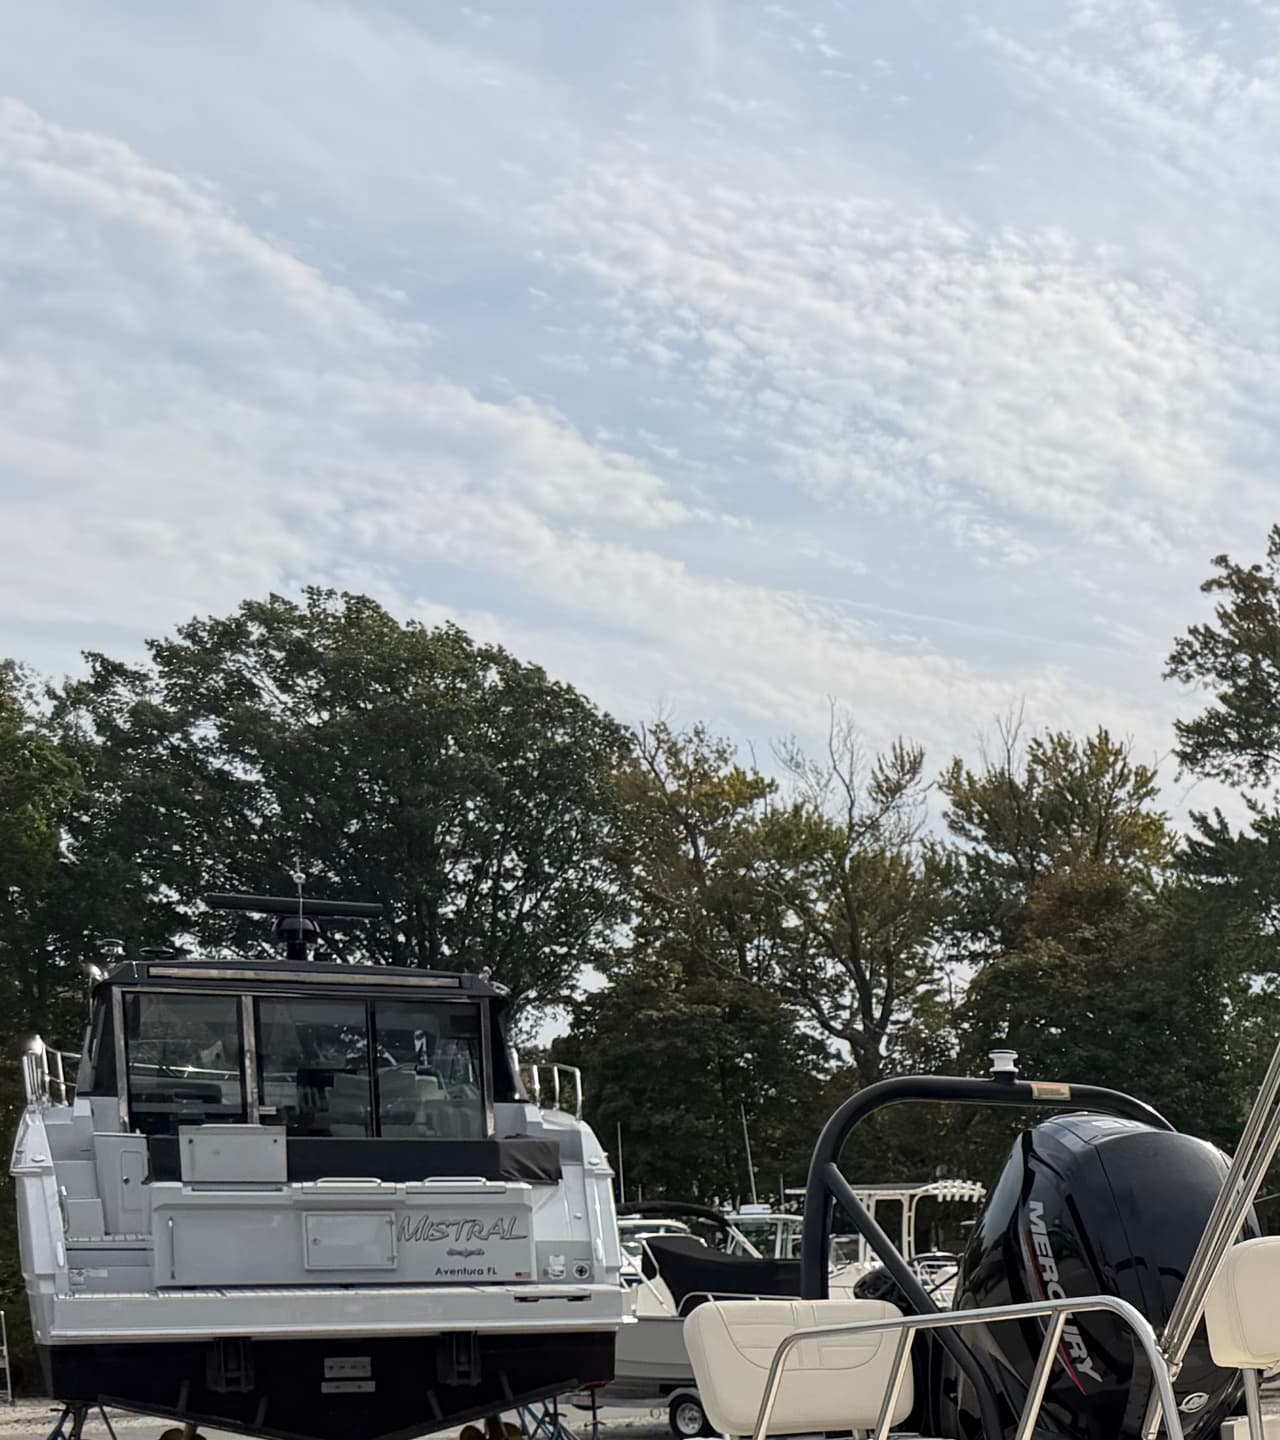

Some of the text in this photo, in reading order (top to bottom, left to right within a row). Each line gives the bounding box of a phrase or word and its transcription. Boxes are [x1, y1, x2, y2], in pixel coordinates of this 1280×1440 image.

[398, 1214, 529, 1242] MISTRAL
[435, 1266, 498, 1277] Aventura FL
